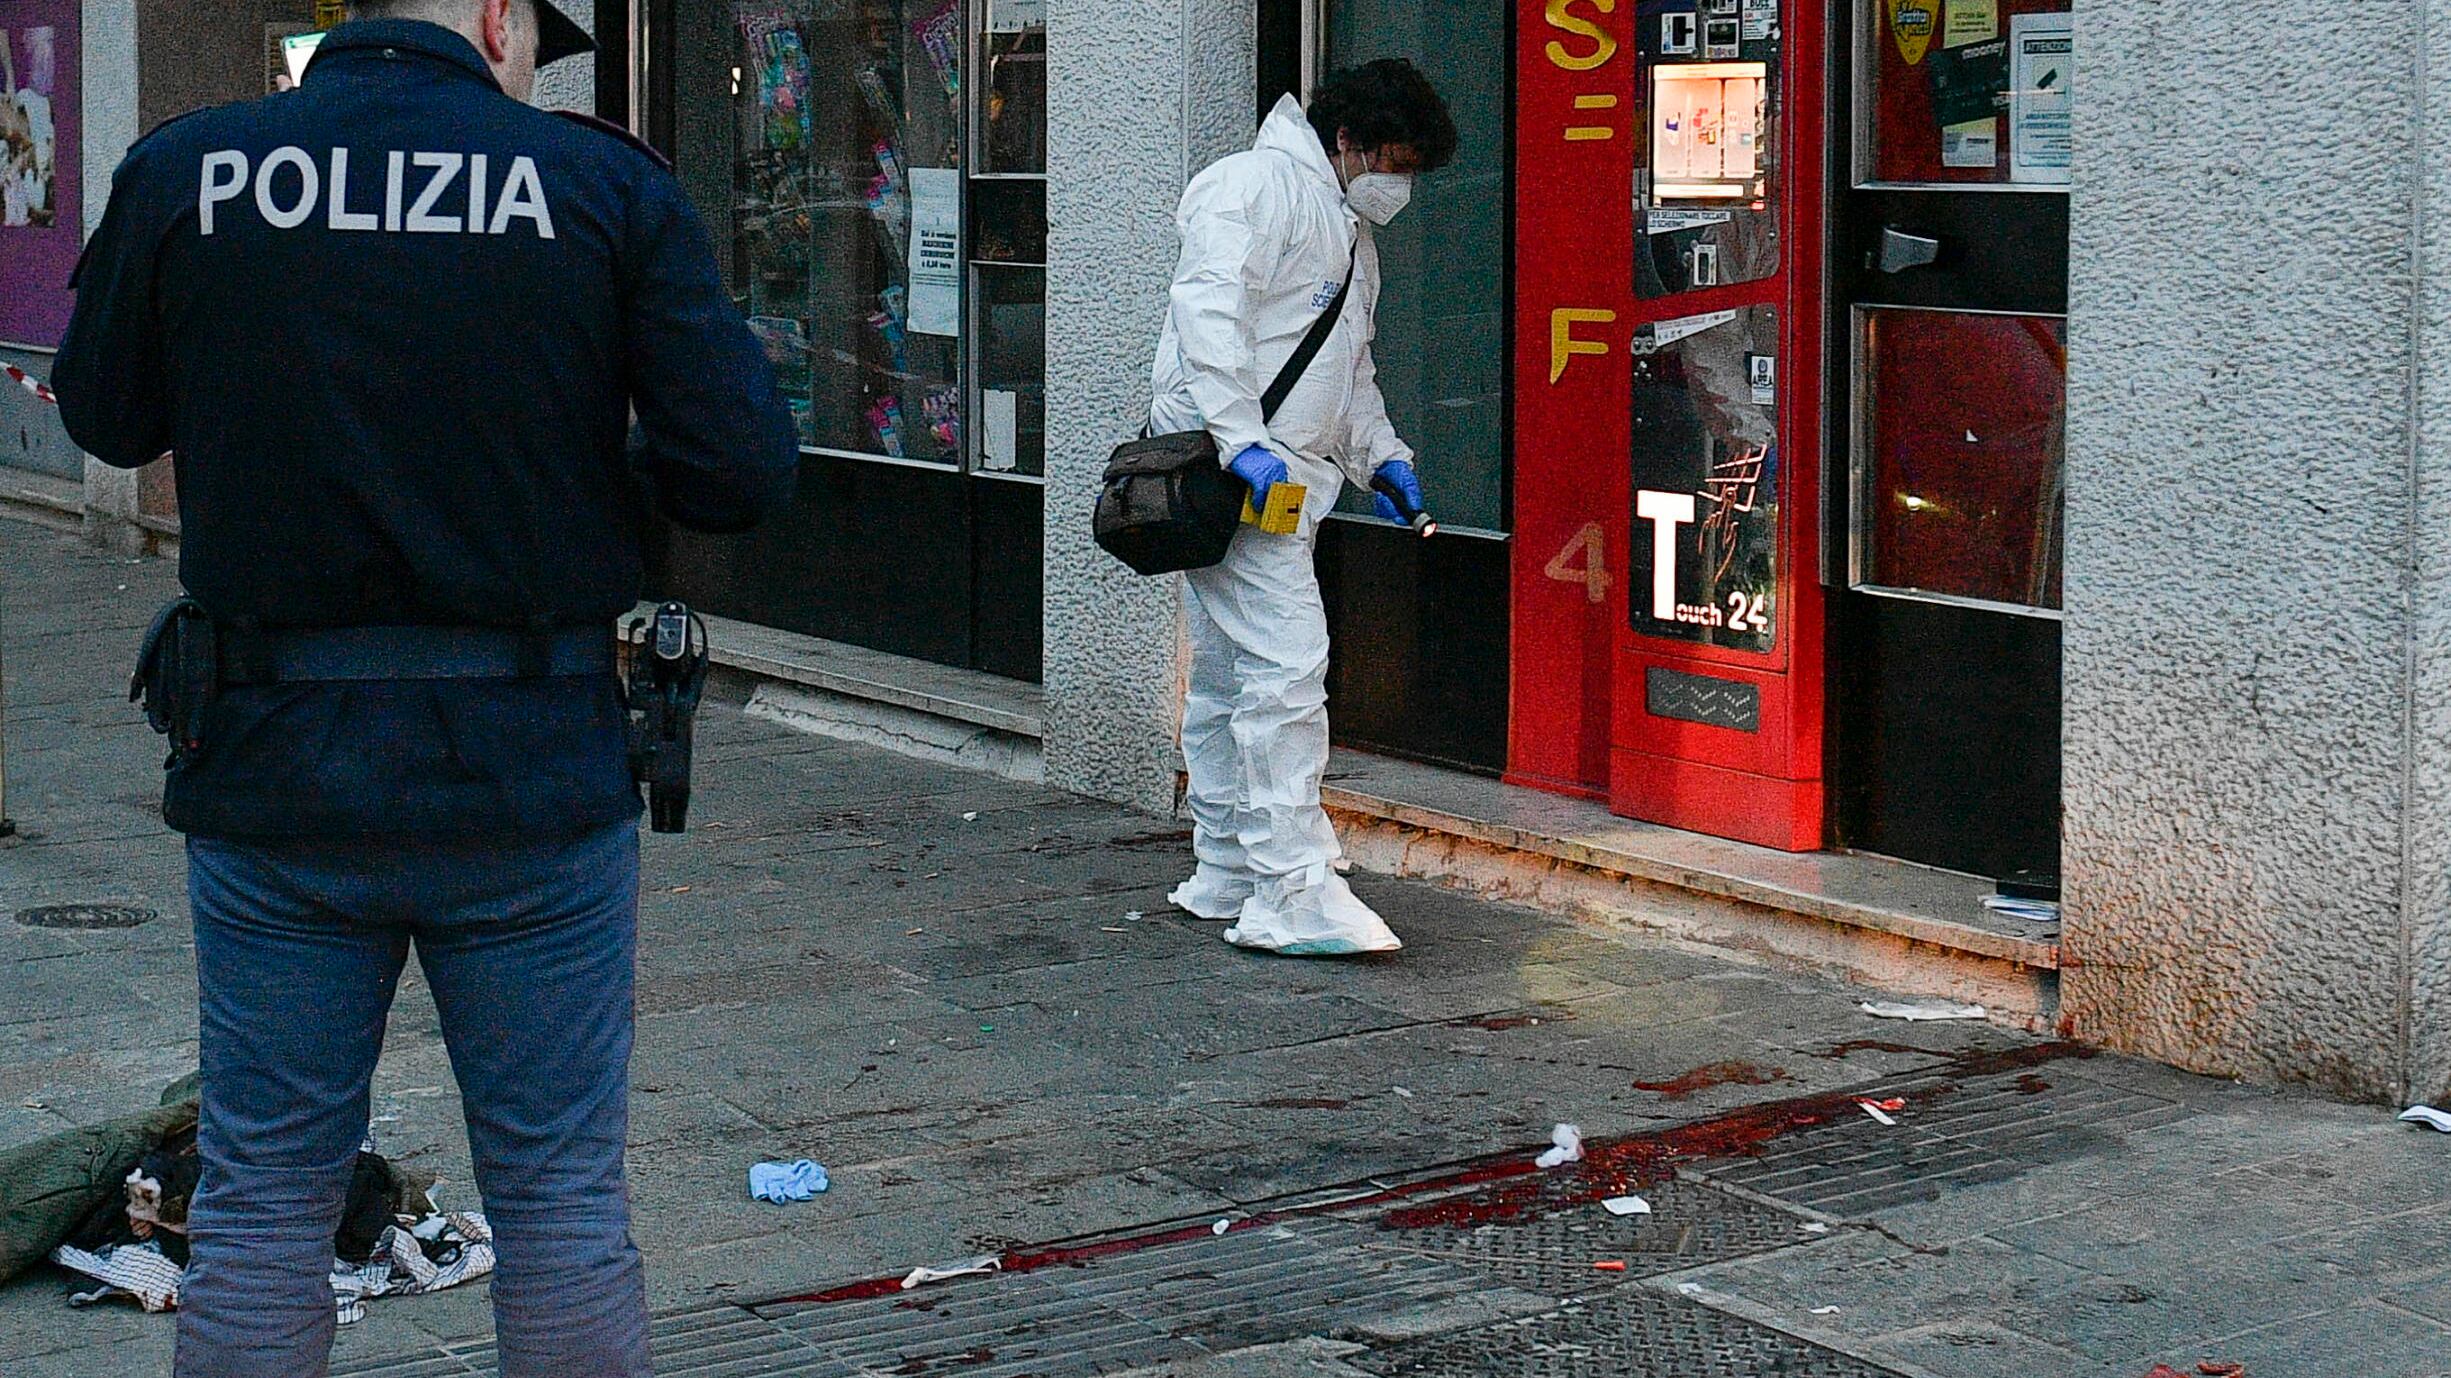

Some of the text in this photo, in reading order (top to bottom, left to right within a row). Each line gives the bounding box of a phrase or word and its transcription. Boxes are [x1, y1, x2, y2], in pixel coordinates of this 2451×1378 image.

[200, 145, 555, 239] POLIZIA
[1637, 489, 1769, 633] Touch 24
